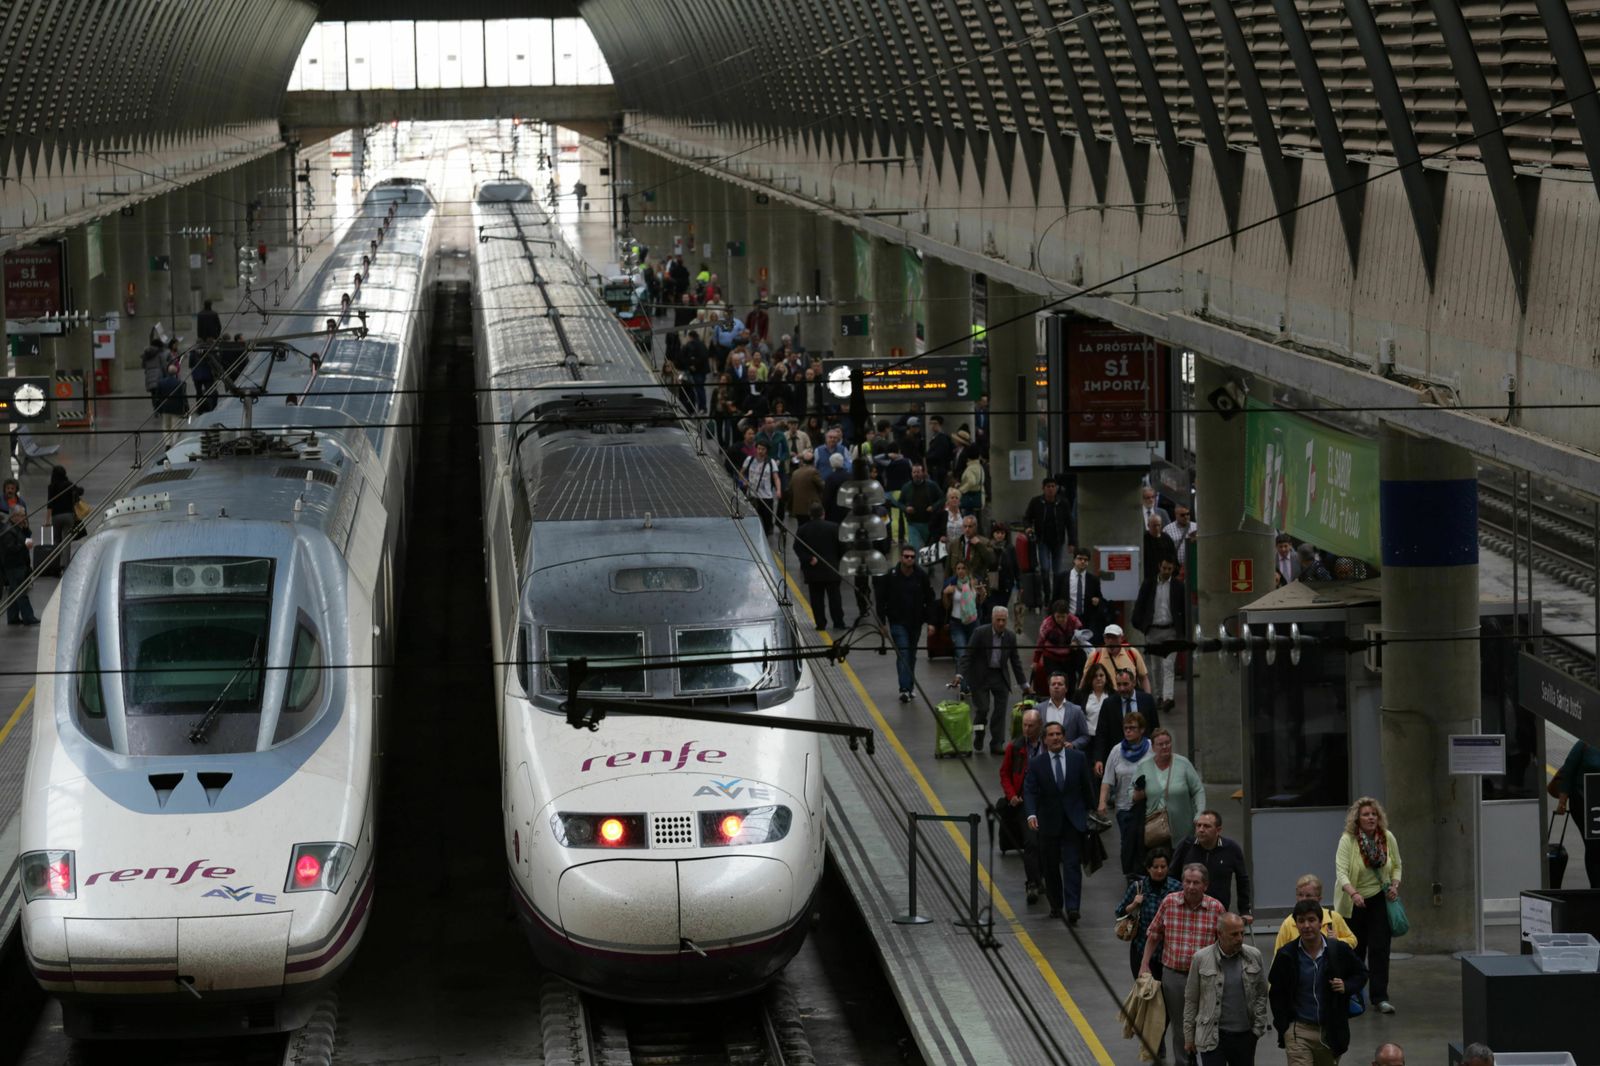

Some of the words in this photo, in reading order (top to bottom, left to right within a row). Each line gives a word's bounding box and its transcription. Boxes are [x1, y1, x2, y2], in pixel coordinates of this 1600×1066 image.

[842, 324, 849, 337] 3
[31, 344, 39, 356] 4
[1079, 343, 1093, 353] LA
[1104, 354, 1129, 377] SÍ
[956, 378, 969, 397] 3
[1083, 380, 1150, 392] IMPORTA
[1541, 680, 1556, 706] Sevilla
[1556, 688, 1569, 714] Santa
[580, 740, 738, 773] renfe
[693, 777, 770, 801] AVE
[84, 858, 237, 887] renfe
[199, 884, 281, 905] AVE
